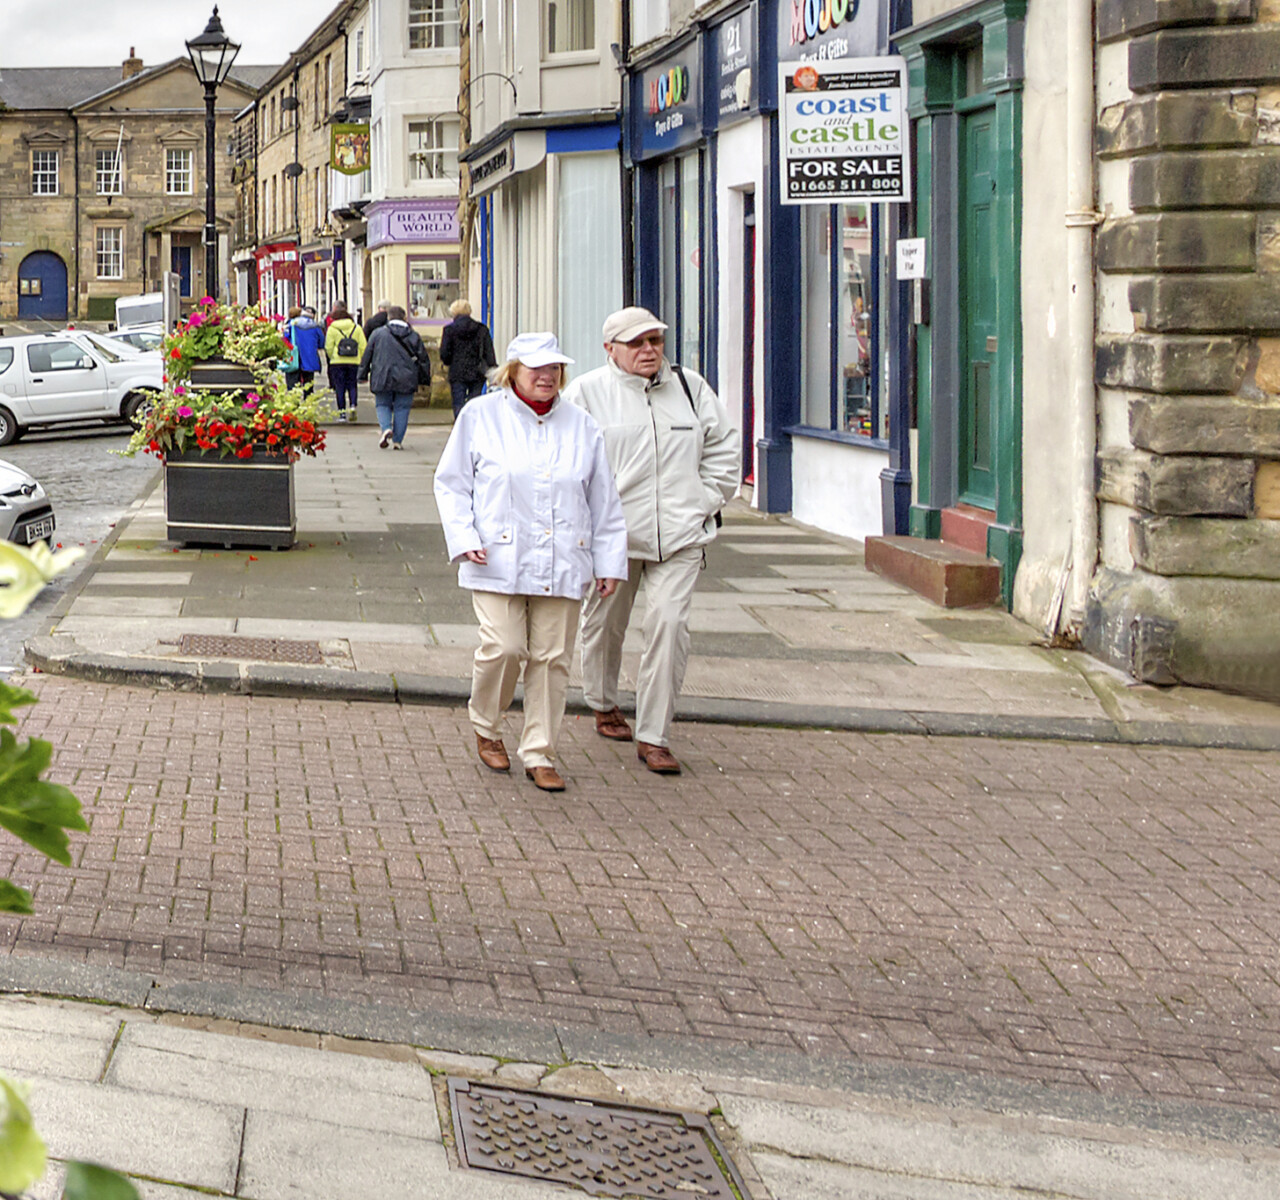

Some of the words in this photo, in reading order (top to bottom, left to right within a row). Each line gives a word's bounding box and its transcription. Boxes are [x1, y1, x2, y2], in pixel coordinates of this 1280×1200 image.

[726, 22, 741, 56] 21
[828, 38, 848, 60] Gifts
[649, 65, 682, 116] MOJO
[796, 93, 891, 116] coast
[824, 114, 852, 126] and
[790, 118, 899, 144] castle
[790, 146, 836, 155] ESTATE
[846, 144, 899, 153] AGENTS
[789, 160, 838, 177] FOR
[842, 158, 901, 175] SALE
[790, 180, 835, 191] 01665
[840, 179, 865, 190] 511
[872, 178, 900, 189] 800
[397, 212, 455, 221] BEAUTY
[403, 222, 452, 231] WORLD
